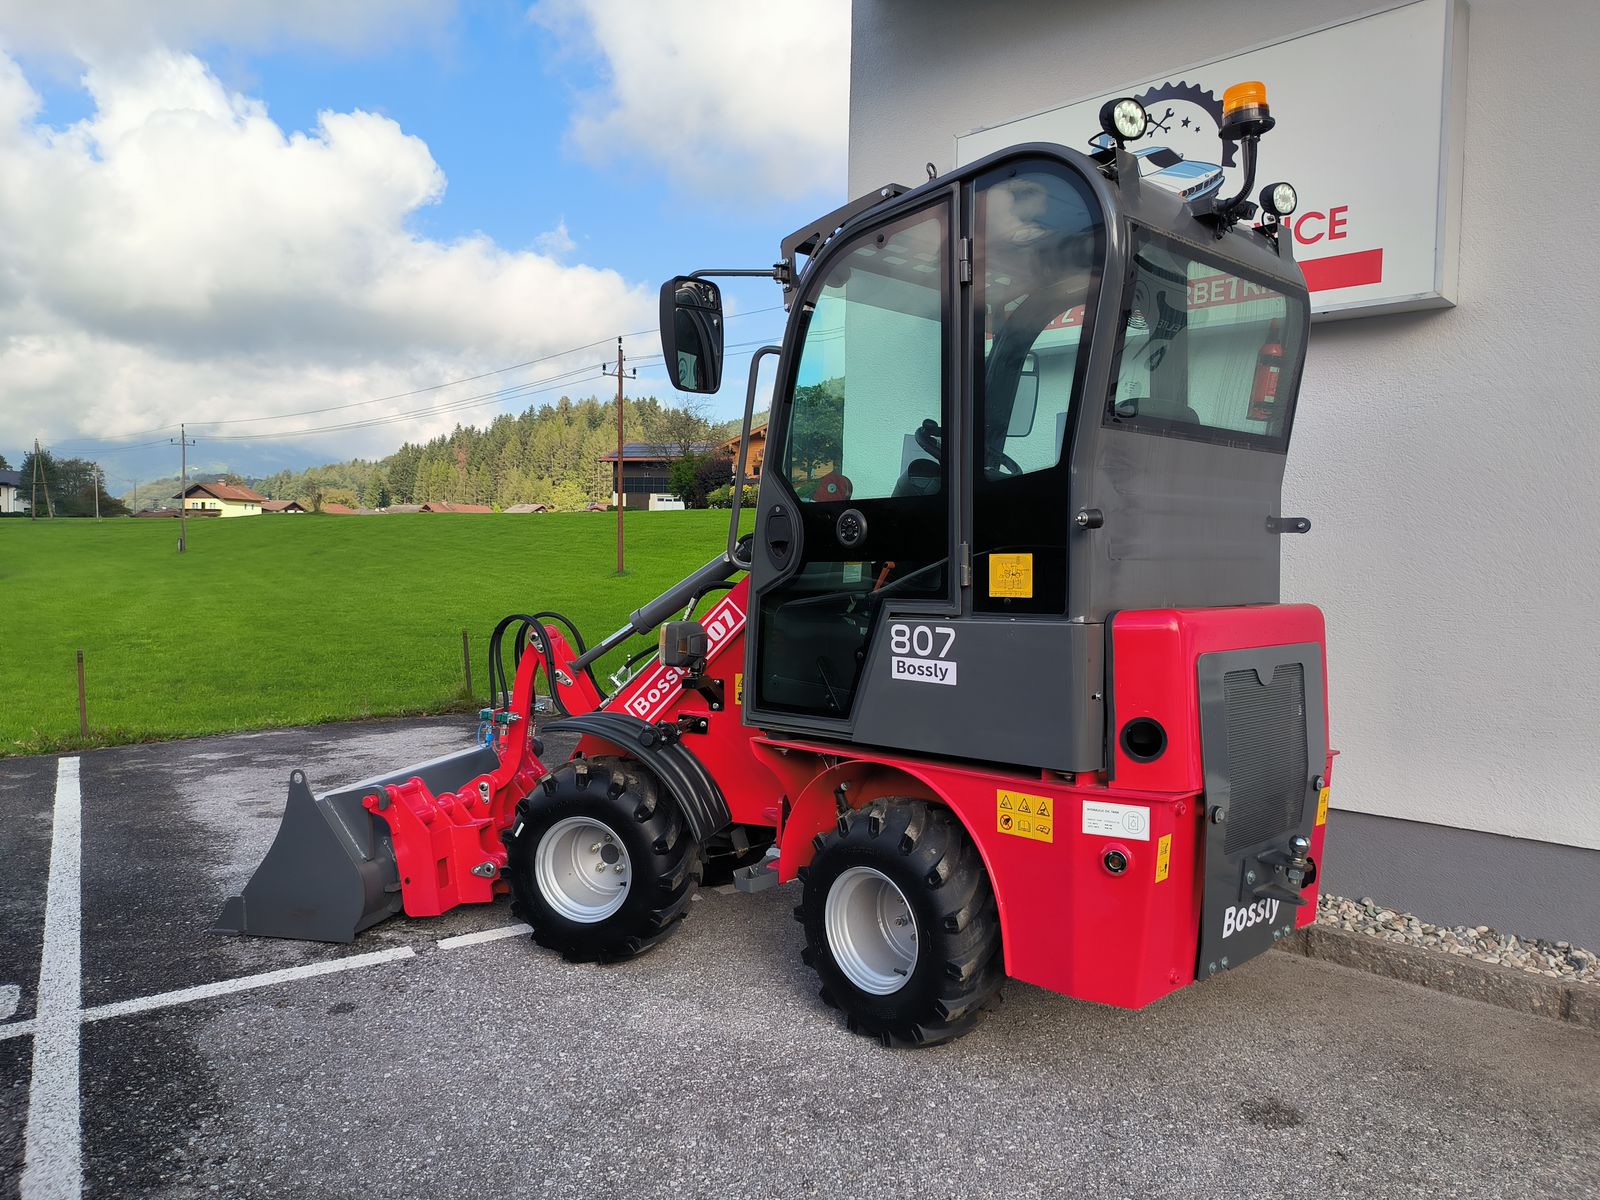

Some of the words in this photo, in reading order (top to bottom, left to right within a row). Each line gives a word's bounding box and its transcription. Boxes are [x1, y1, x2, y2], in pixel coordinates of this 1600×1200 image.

[890, 623, 956, 658] 807
[632, 666, 689, 716] Bossl
[707, 609, 735, 648] 07
[896, 660, 948, 681] Bossly
[1222, 898, 1280, 939] Bossly
